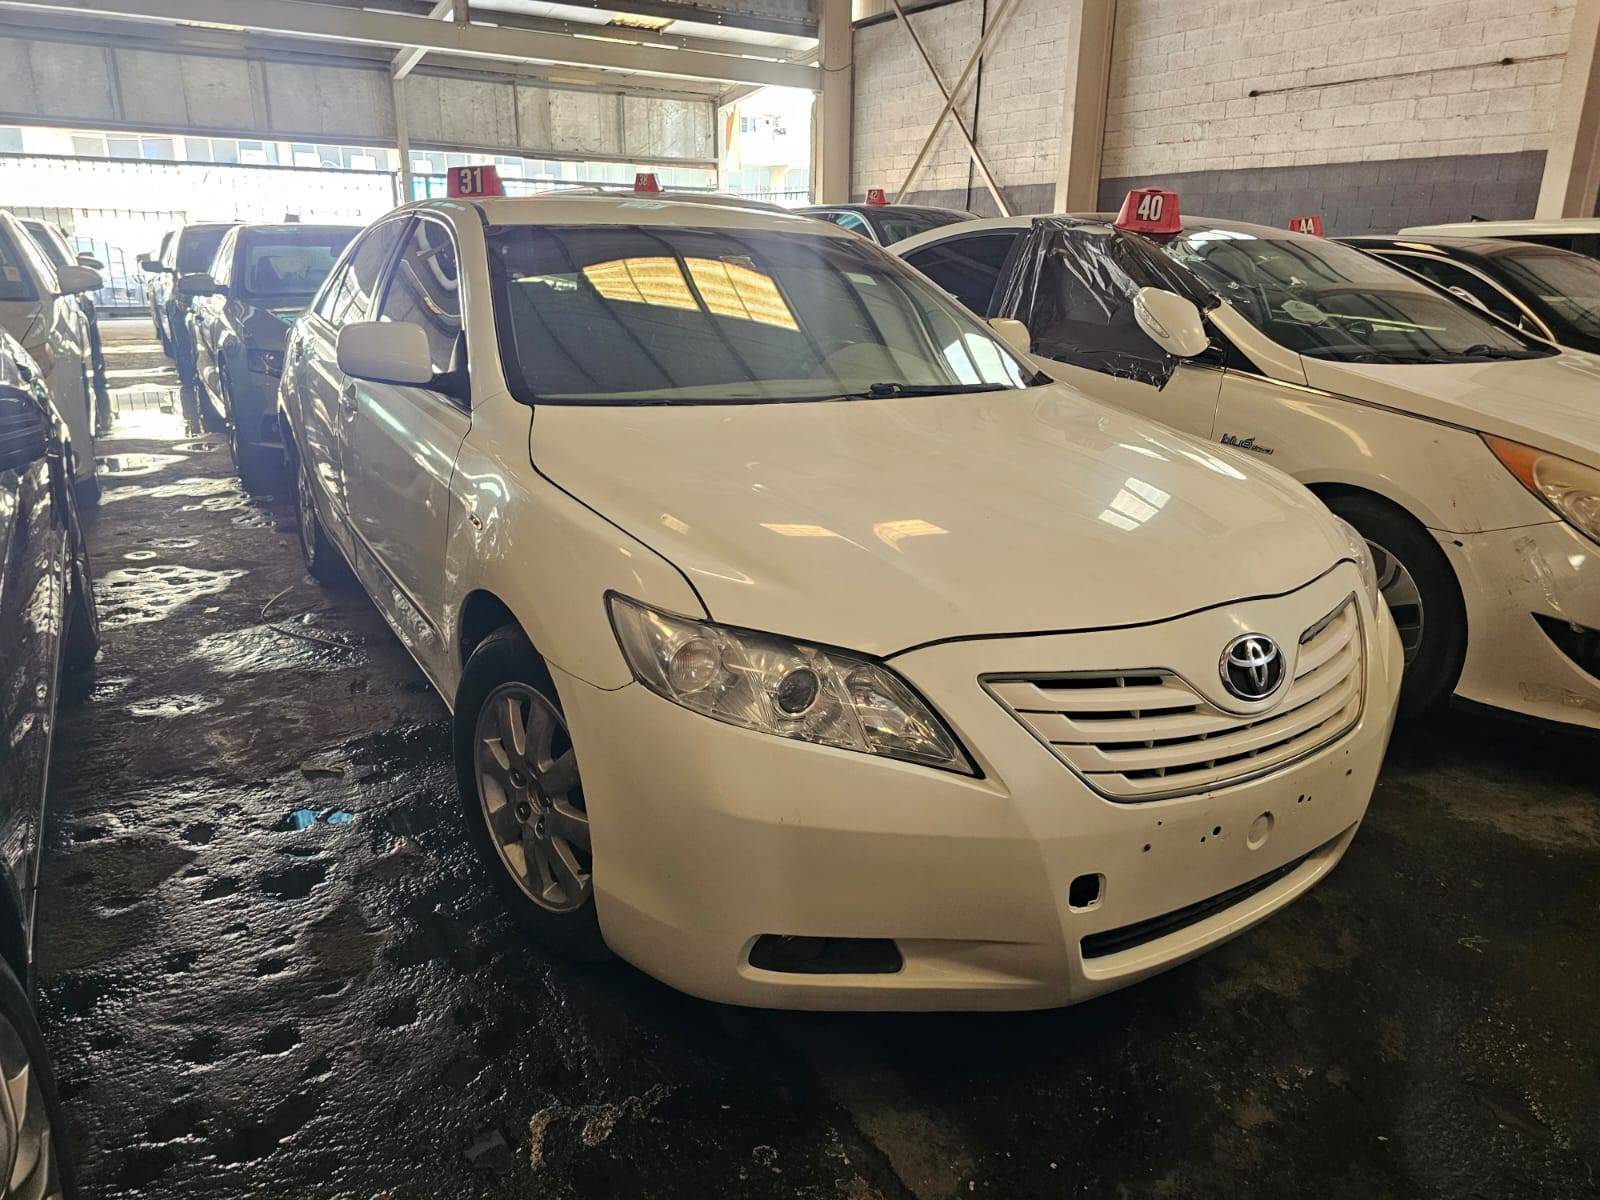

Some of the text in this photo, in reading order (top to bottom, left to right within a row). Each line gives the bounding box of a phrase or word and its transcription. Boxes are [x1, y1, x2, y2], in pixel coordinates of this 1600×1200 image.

[460, 168, 482, 194] 31
[1137, 194, 1164, 221] 40
[1300, 218, 1315, 235] 44
